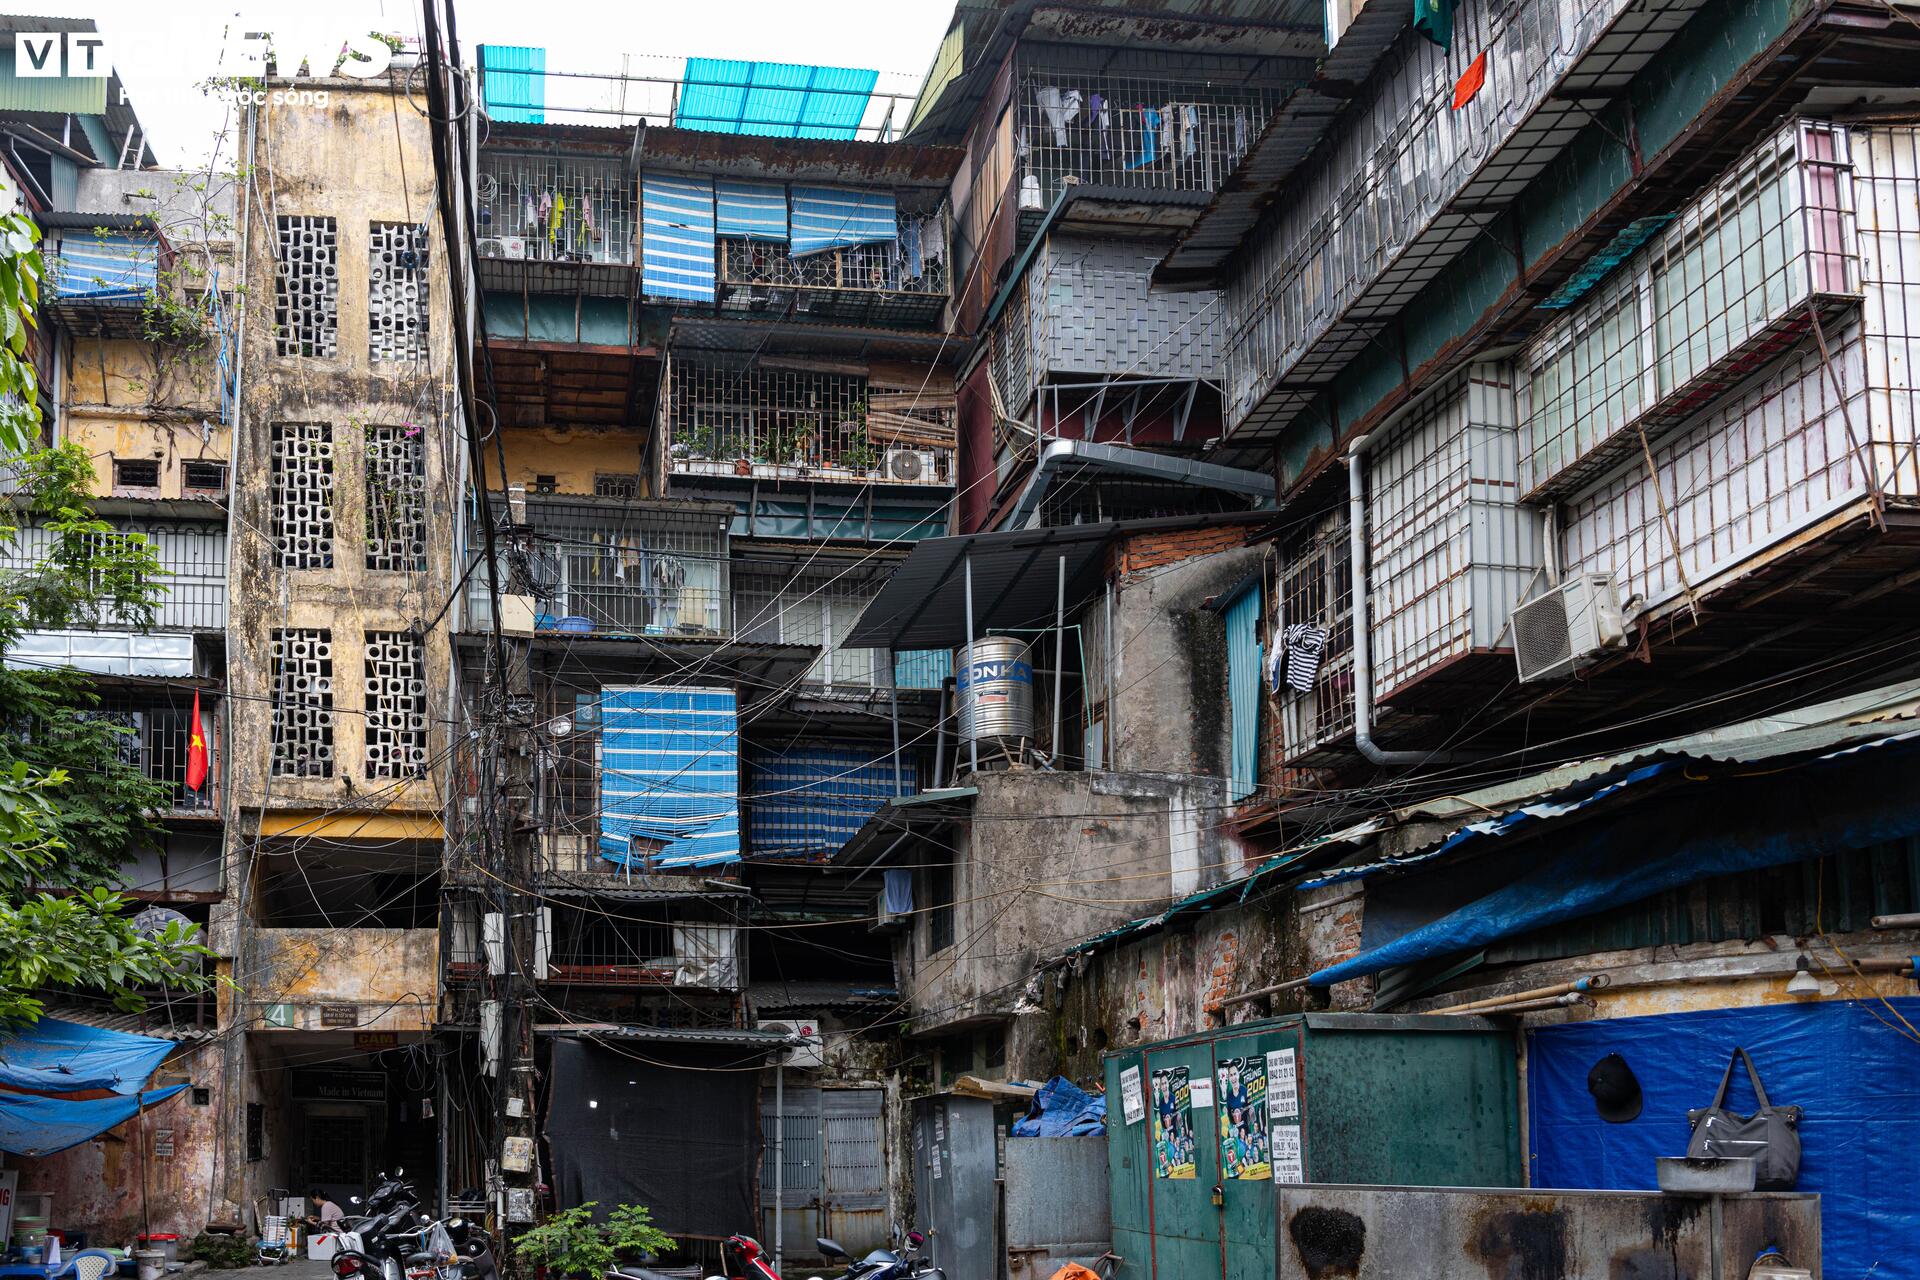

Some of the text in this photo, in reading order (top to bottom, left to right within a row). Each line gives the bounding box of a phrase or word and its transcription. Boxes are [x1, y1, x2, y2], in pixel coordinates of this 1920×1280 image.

[271, 1004, 287, 1027] 4
[319, 1086, 384, 1098] Made in Vietnam
[1246, 1075, 1266, 1097] 200
